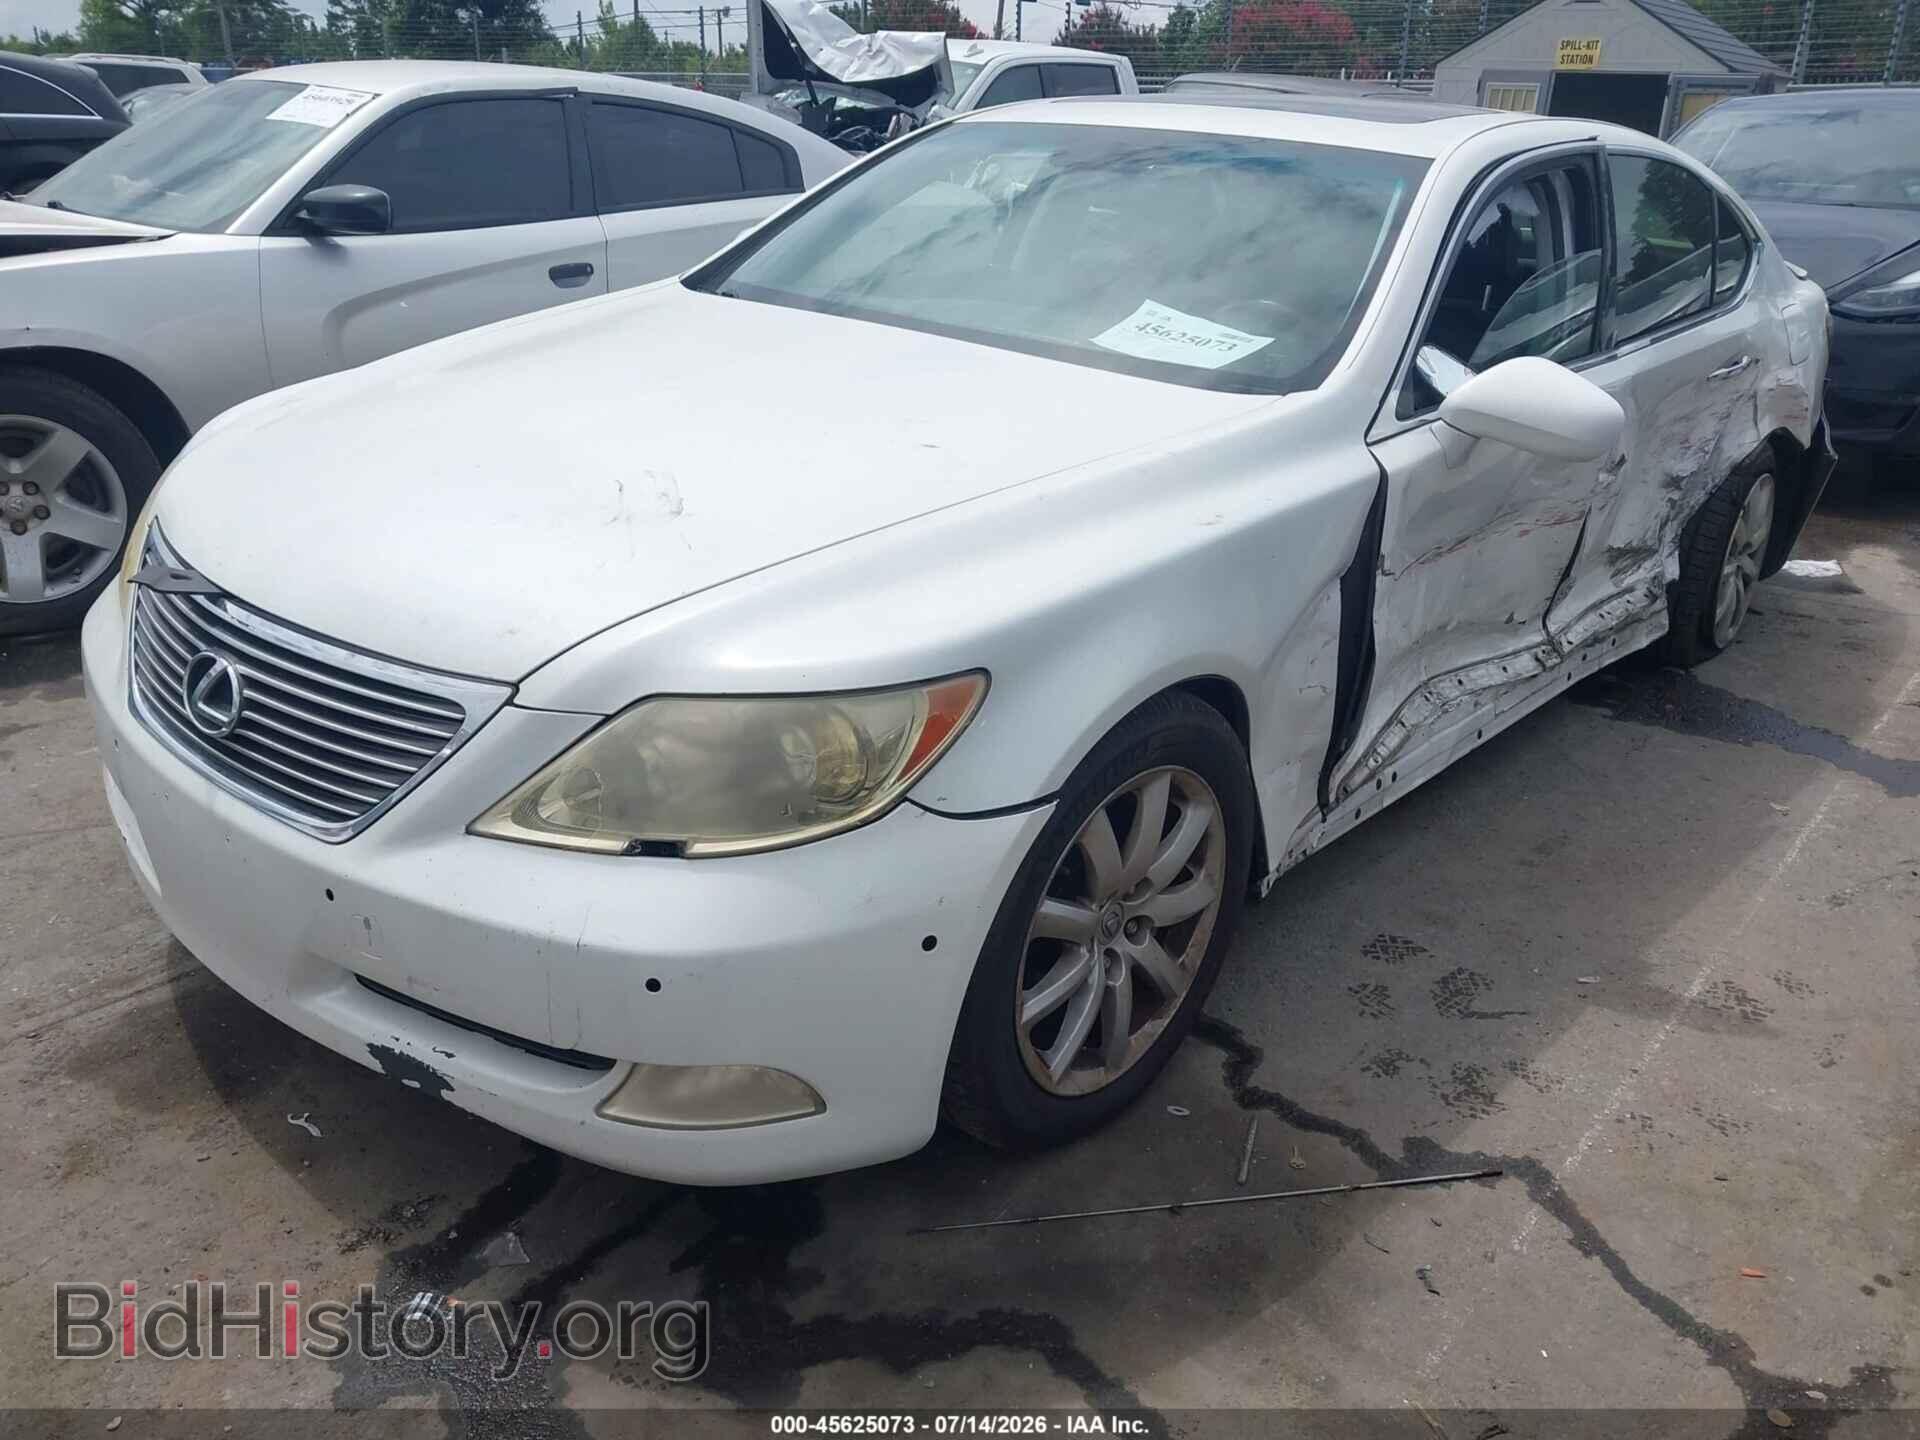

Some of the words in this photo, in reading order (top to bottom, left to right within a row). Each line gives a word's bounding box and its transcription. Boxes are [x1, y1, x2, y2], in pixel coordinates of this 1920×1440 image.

[1560, 40, 1600, 50] SPILL-KIT
[1560, 54, 1594, 65] STATION
[1134, 322, 1238, 352] 45625073
